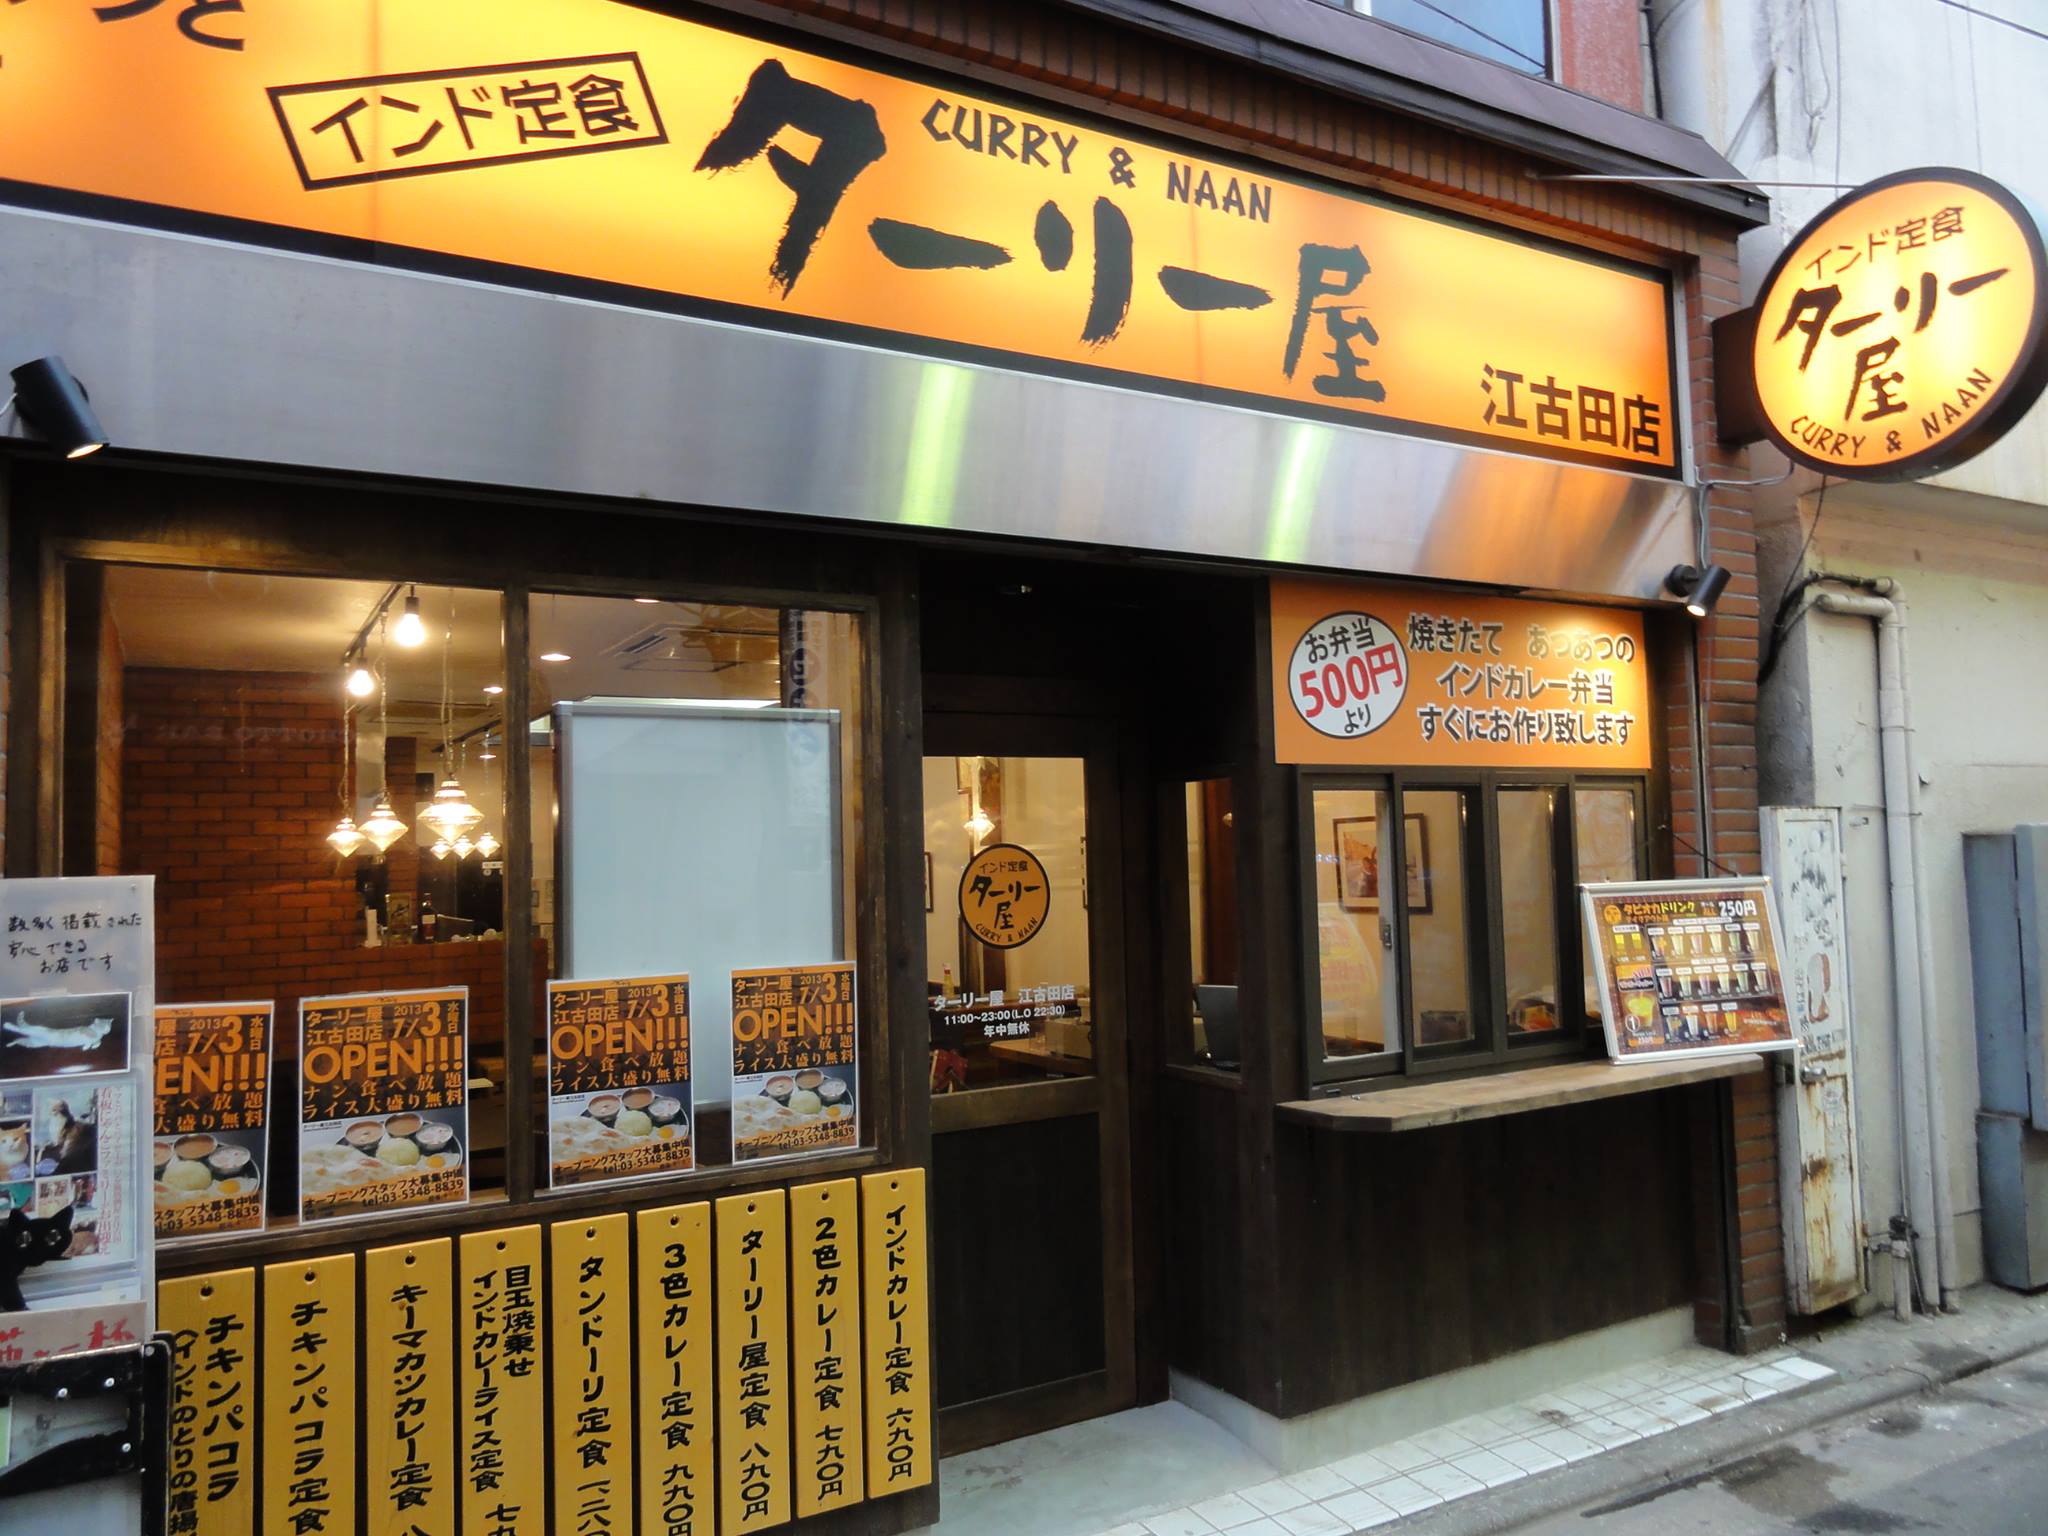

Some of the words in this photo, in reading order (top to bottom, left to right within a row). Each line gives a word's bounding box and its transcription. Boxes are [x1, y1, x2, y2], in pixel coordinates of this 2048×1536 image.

[310, 73, 640, 163] インド定食
[921, 98, 1078, 174] CURRY
[1108, 146, 1137, 190] &
[1166, 161, 1272, 224] NAAN
[694, 57, 1387, 403] ターリー屋
[1804, 205, 1965, 280] インド定食
[1773, 266, 2012, 374] ターリー
[1843, 336, 1908, 422] 屋
[1480, 362, 1661, 457] 江古田店
[1790, 414, 1866, 459] CURRY
[1885, 430, 1903, 453] &
[1921, 367, 1994, 440] NAAN
[1304, 617, 1376, 664] お弁当
[1407, 611, 1504, 656] 焼きたて
[1526, 623, 1636, 664] あつあつの
[1299, 642, 1404, 718] 500円
[1435, 663, 1615, 706] インドカレー弁当
[1344, 703, 1372, 734] より
[1416, 704, 1635, 746] すぐにお作り致します
[980, 860, 1029, 874] インド定食
[968, 875, 1041, 908] ターリー
[1718, 899, 1758, 917] 250円
[975, 923, 1002, 943] CURRY
[1018, 916, 1039, 939] NAAN
[994, 900, 1014, 930] 屋
[553, 988, 619, 1008] ターリー屋
[628, 986, 651, 998] 2013
[735, 975, 793, 993] ターリー屋
[735, 991, 793, 1009] 江古田店
[800, 974, 823, 985] 2013
[934, 990, 1004, 1012] ターリー屋
[1018, 984, 1076, 1004] 江古田店
[154, 1018, 177, 1037] 屋
[190, 1018, 222, 1030] 2013
[305, 1005, 384, 1028] ターリー屋
[393, 1004, 422, 1017] 2013
[554, 1005, 619, 1025] 江古田店
[734, 1002, 854, 1042] OPEN!!!
[984, 1021, 1031, 1037] 年中無休
[306, 1024, 384, 1046] 江古田店
[551, 1016, 689, 1060] OPEN!!!
[154, 1053, 266, 1095] EN!!!
[303, 1035, 463, 1084] OPEN!!!
[551, 1065, 689, 1093] ライス大盛り無料
[735, 1049, 854, 1073] ライス大盛り無料
[303, 1089, 463, 1120] ライス大盛り無料
[502, 1264, 535, 1377] 目玉焼乗せ
[812, 1216, 844, 1412] 2色カレー定食
[885, 1204, 913, 1395] インドカレー定食
[659, 1243, 694, 1450] 3色カレー定食
[738, 1230, 771, 1430] ターリー屋定食
[470, 1270, 504, 1493] インドカレーライス定食
[576, 1256, 612, 1469] タンドーリ定食
[203, 1314, 245, 1502] チキンパコラ
[288, 1300, 330, 1535] チキンパコラ定食
[390, 1284, 433, 1512] キーマカツカレー定食
